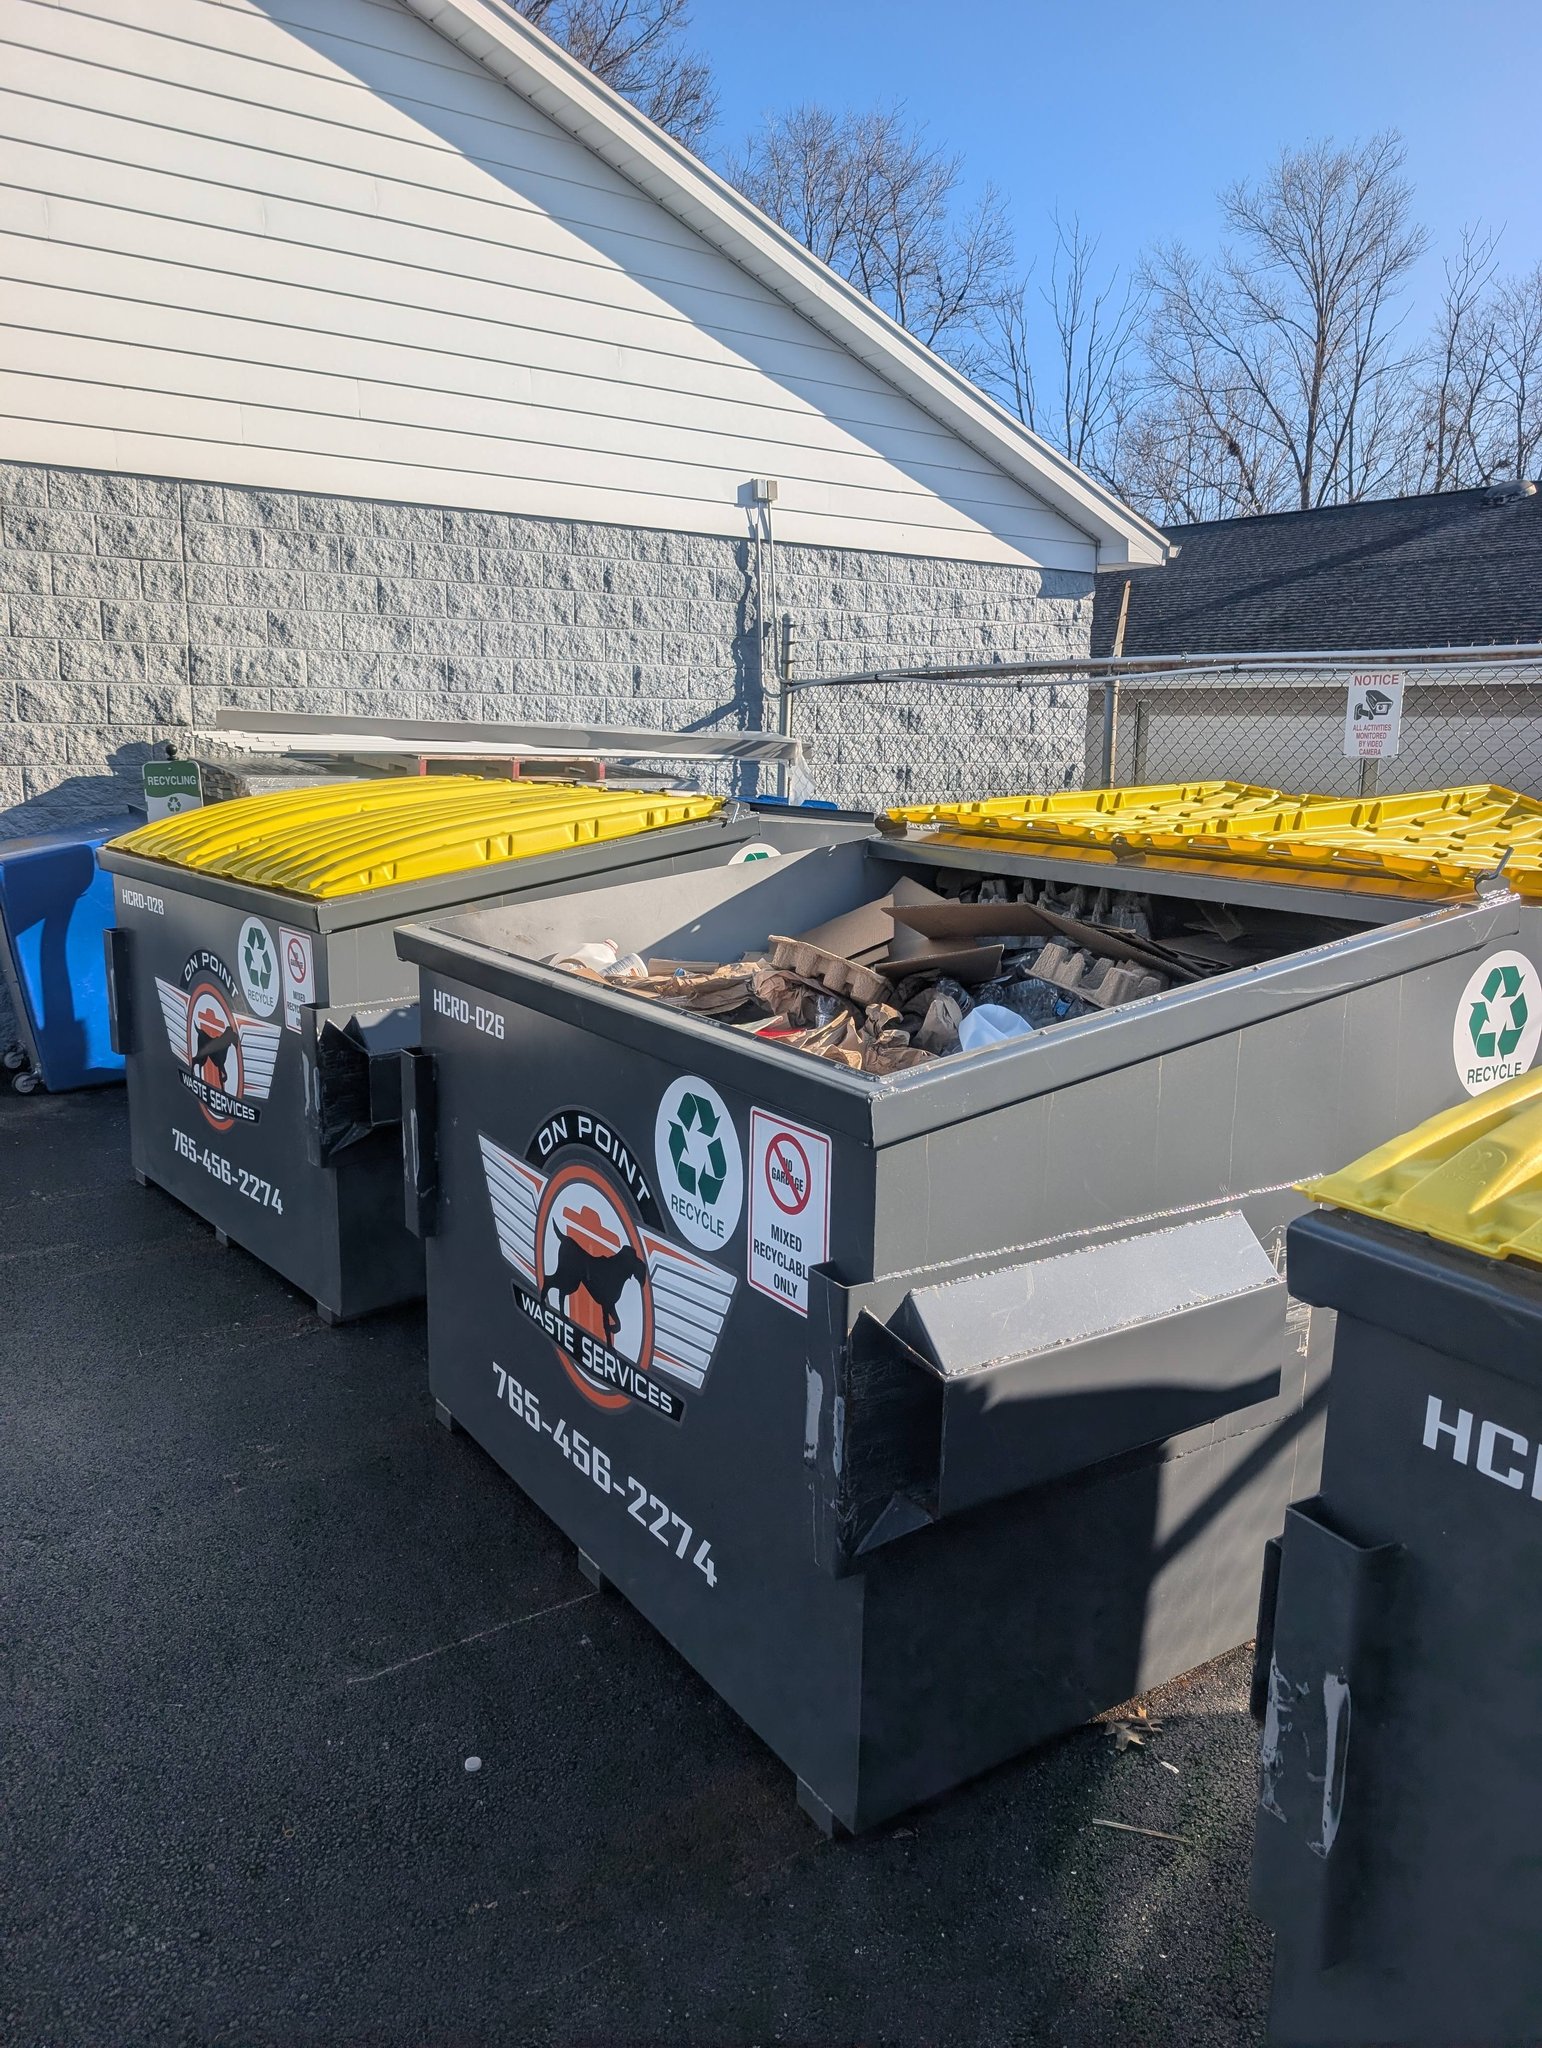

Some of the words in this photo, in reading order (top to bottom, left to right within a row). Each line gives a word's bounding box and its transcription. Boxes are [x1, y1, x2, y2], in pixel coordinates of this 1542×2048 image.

[1354, 674, 1400, 686] NOTICE
[1355, 732, 1387, 740] MONITORED
[1363, 723, 1392, 731] ACTIVITIES
[1358, 748, 1382, 756] CAMERA
[147, 775, 197, 786] RECYCLING
[184, 954, 199, 982] ON
[201, 952, 239, 998] POINT
[247, 989, 275, 1008] RECYCLE
[1466, 1061, 1522, 1085] RECYCLE
[181, 1072, 208, 1102] WASTE
[209, 1090, 256, 1121] SERVICES
[171, 1127, 284, 1216] 765-456-2274
[538, 1116, 569, 1156] ON
[577, 1115, 651, 1202] POINT
[771, 1166, 804, 1193] GARBGE
[671, 1193, 725, 1239] RECYCLE
[771, 1223, 803, 1253] MIXED
[753, 1237, 809, 1282] RECYCLABL
[773, 1272, 798, 1299] ONLY
[520, 1292, 574, 1354] WASTE
[581, 1336, 673, 1414] SERVICES
[1422, 1394, 1542, 1502] HC
[492, 1361, 718, 1588] 765-456-2274
